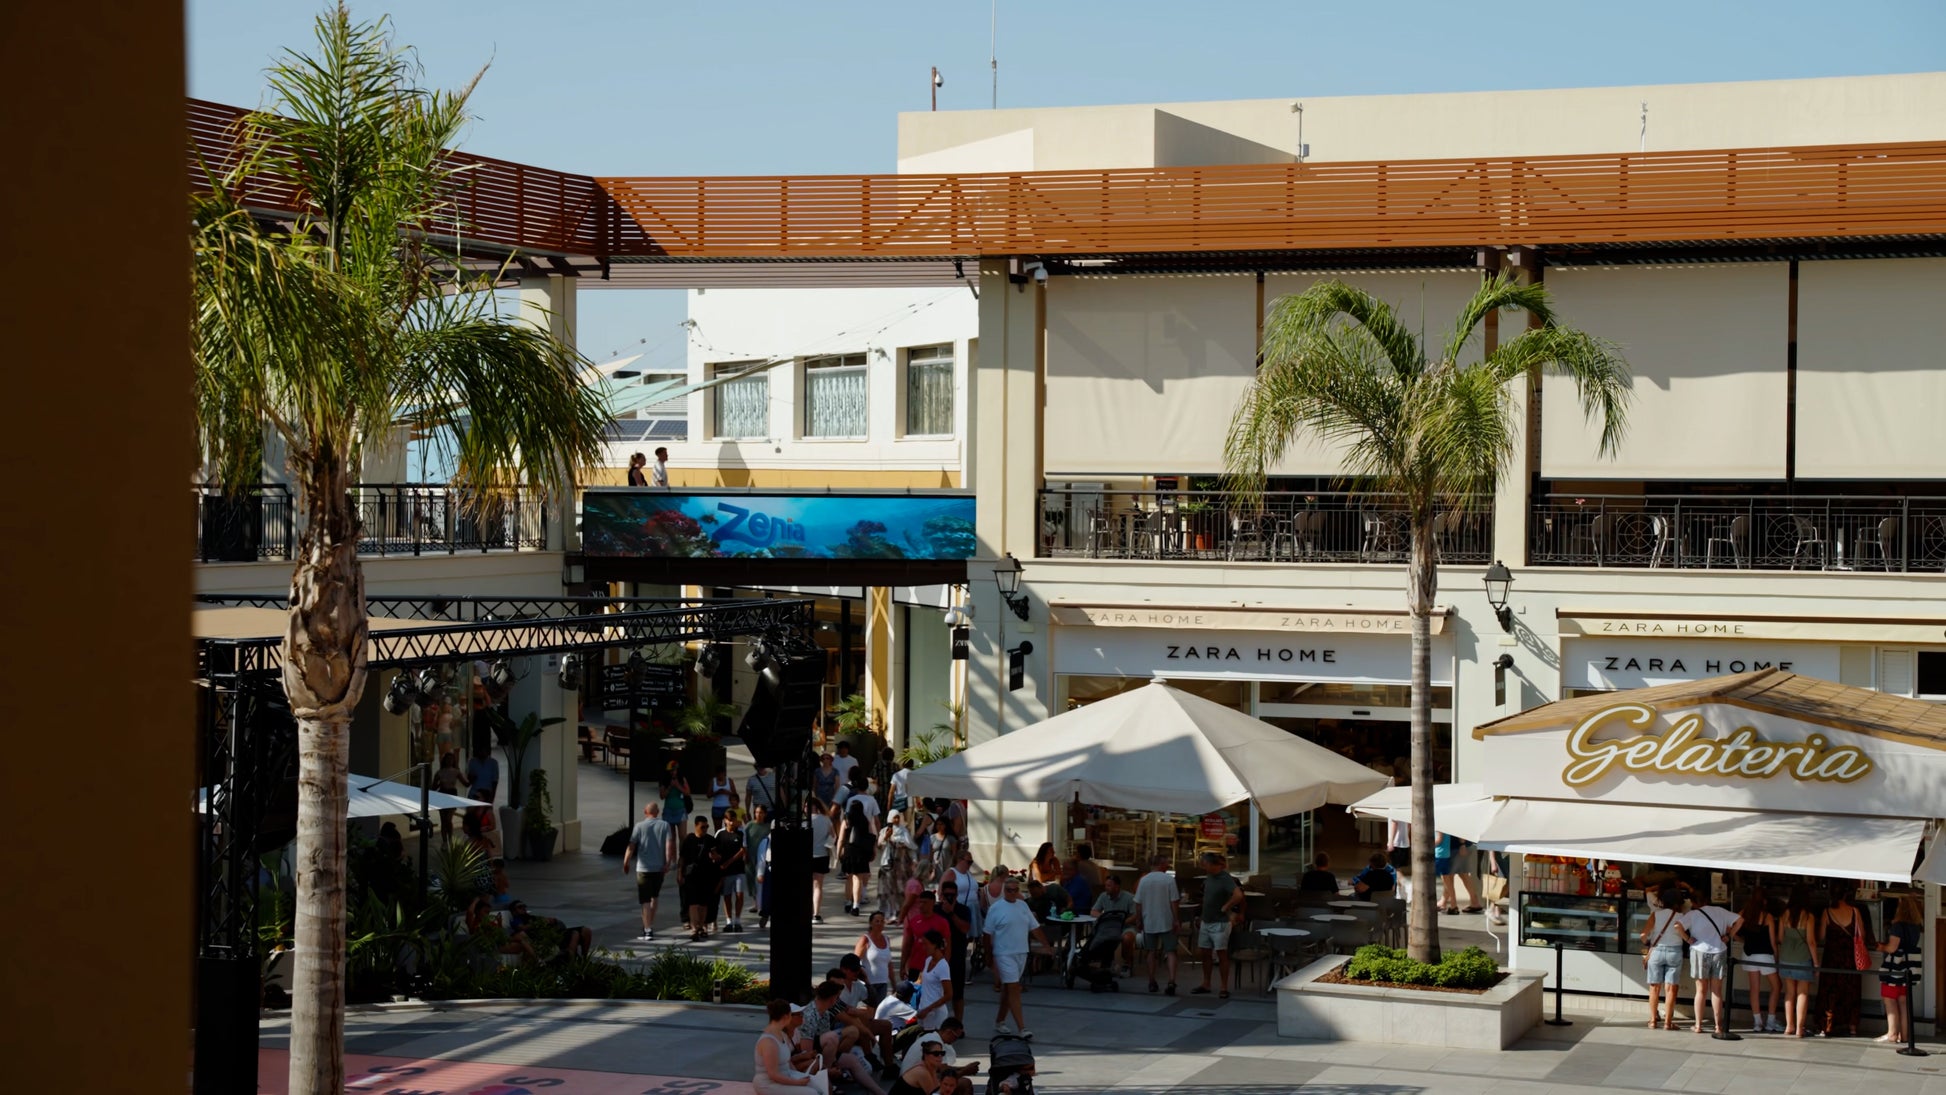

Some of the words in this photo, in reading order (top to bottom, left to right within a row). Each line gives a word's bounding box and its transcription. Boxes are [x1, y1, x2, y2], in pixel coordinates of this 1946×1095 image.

[712, 502, 806, 548] Zenia
[1088, 614, 1138, 622] ZARA
[1148, 614, 1204, 624] HOME
[1281, 617, 1334, 627] ZARA
[1345, 619, 1403, 629] HOME
[1603, 622, 1664, 632] ZARA
[1677, 624, 1744, 634] HOME
[1167, 646, 1241, 660] ZARA
[1257, 648, 1336, 663] HOME
[1605, 657, 1687, 672] ZARA
[1564, 703, 1870, 785] Gelateria
